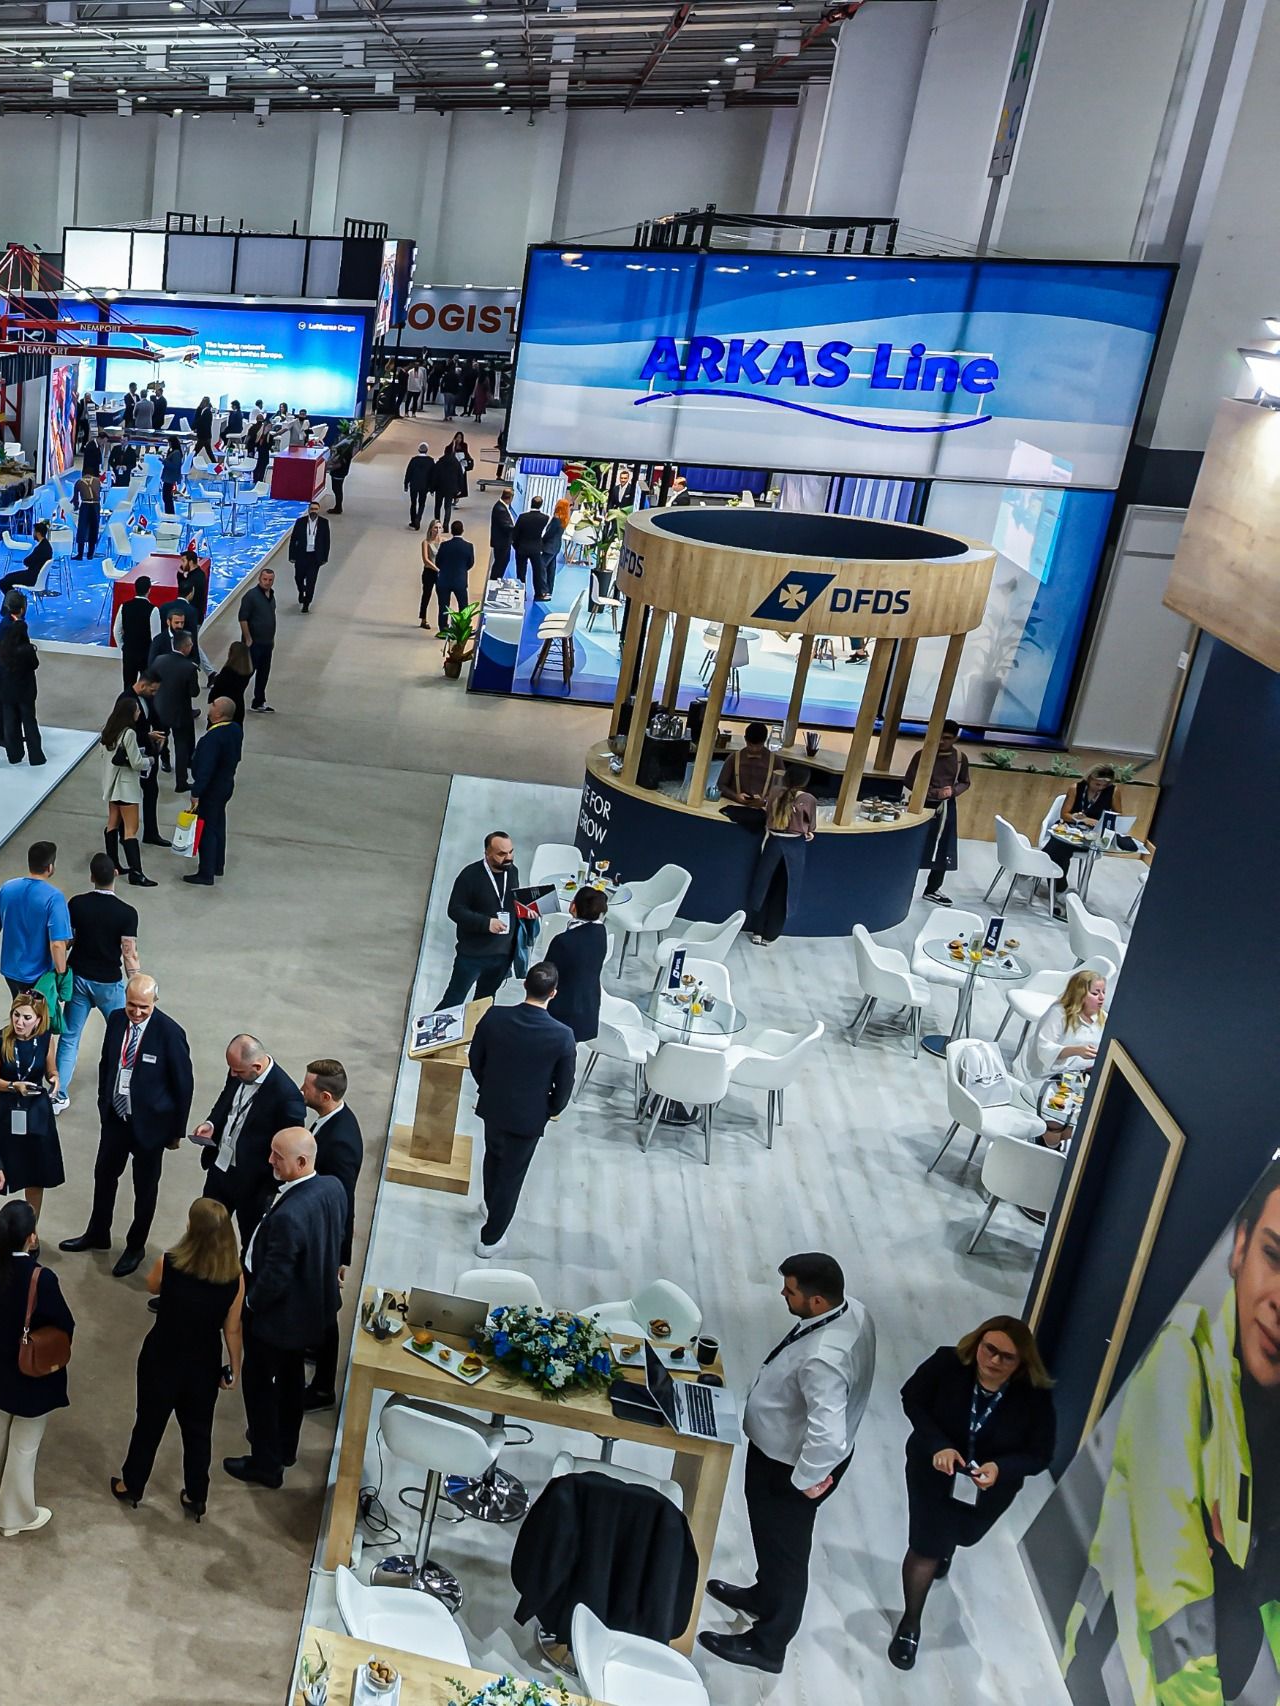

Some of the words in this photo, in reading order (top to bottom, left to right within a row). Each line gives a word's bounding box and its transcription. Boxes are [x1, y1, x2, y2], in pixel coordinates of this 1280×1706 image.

[80, 323, 122, 333] NEMPORT
[337, 324, 356, 333] Cargo
[388, 302, 518, 335] OGIST
[18, 345, 70, 356] NEMPORT
[639, 336, 854, 388] ARKAS
[870, 342, 1000, 394] Line
[829, 588, 911, 615] DFDS
[589, 790, 612, 821] FOR
